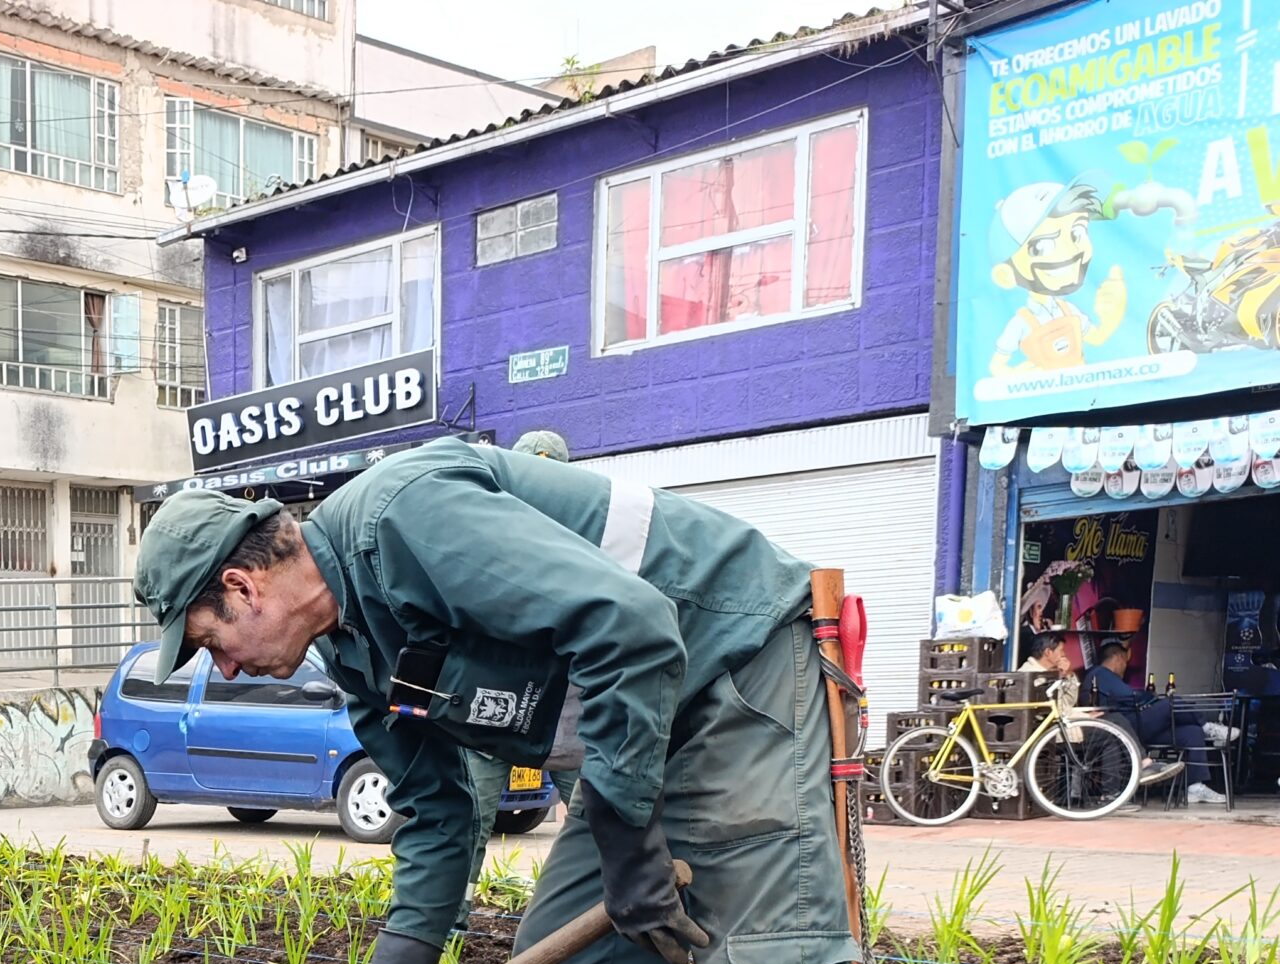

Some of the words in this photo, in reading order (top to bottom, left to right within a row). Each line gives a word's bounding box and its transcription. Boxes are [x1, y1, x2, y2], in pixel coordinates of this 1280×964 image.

[989, 22, 1222, 116] ECOAMIGABLE
[991, 60, 1009, 77] TE
[1012, 30, 1111, 73] OFRECEMOS
[1115, 20, 1140, 44] UN
[1145, 0, 1222, 36] LAVADO
[987, 136, 1019, 158] CON
[1022, 133, 1036, 151] EL
[1039, 117, 1108, 147] AHORRO
[1111, 109, 1132, 130] DE
[1134, 86, 1220, 137] AGUA
[989, 106, 1061, 137] ESTAMOS
[1065, 64, 1222, 118] COMPROMETIDOS
[192, 397, 304, 455] OASIS
[314, 367, 425, 427] CLUB
[1007, 363, 1161, 393] www.lavamax.co
[183, 470, 265, 491] Oasis
[276, 456, 349, 479] Club
[1066, 516, 1103, 560] Me
[520, 681, 534, 708] MAYOR
